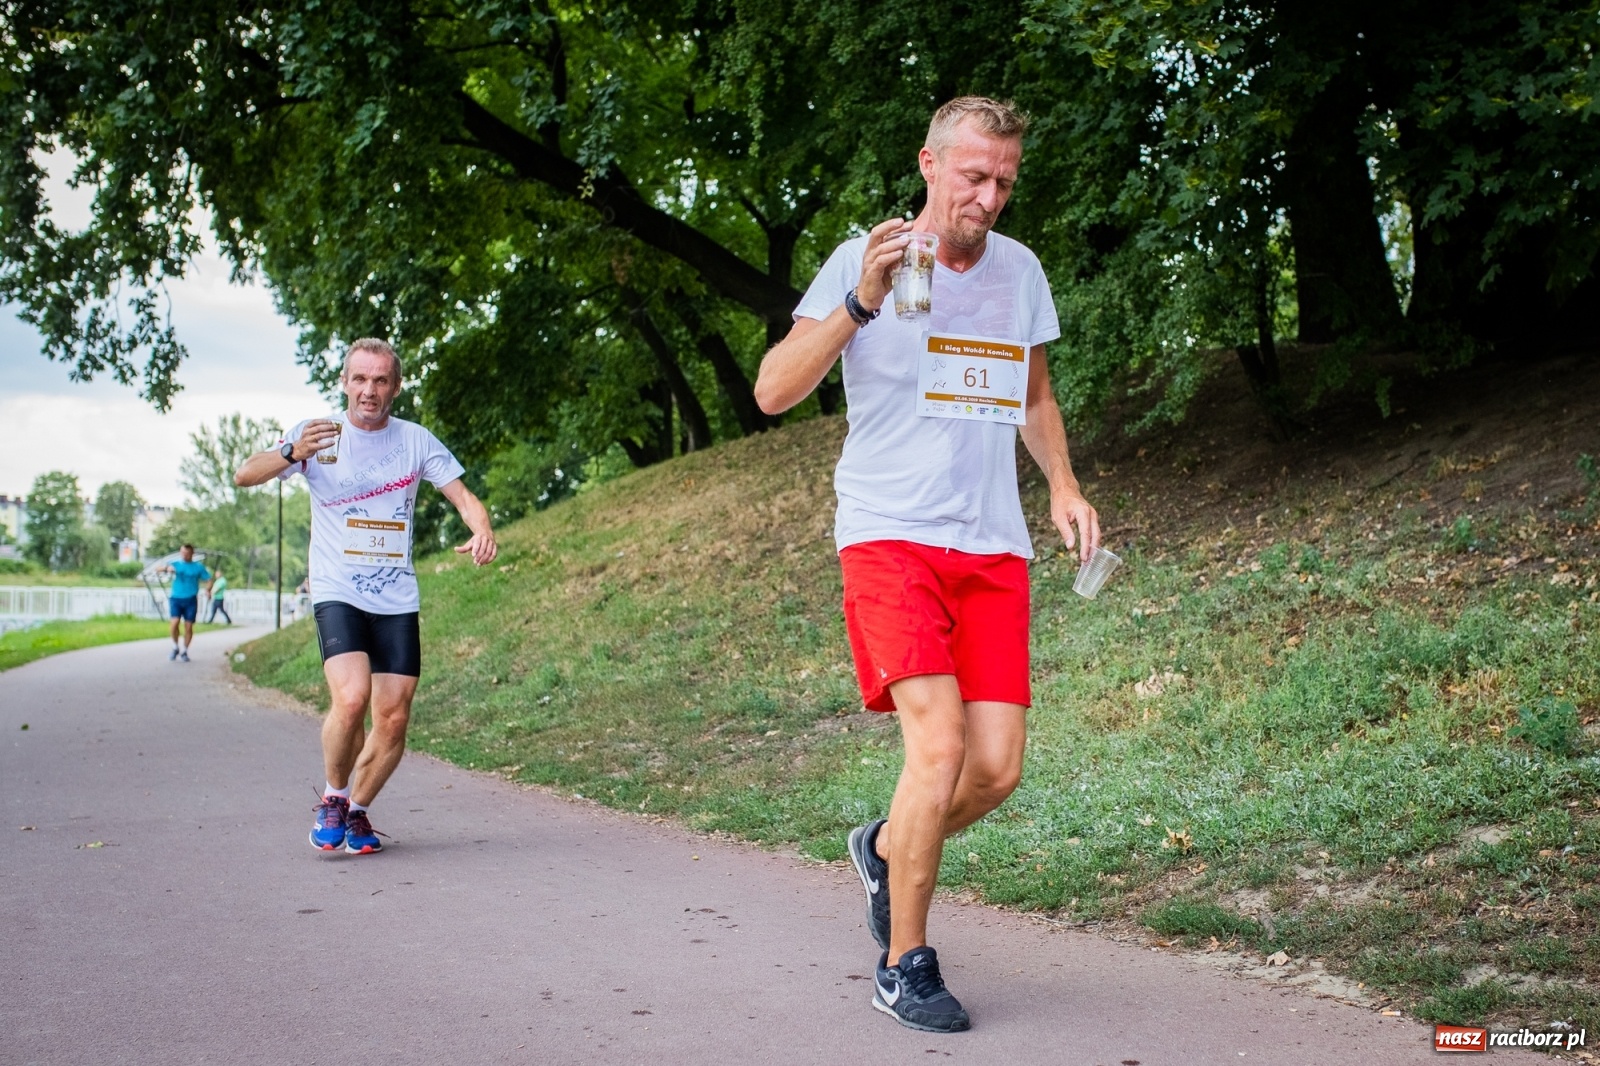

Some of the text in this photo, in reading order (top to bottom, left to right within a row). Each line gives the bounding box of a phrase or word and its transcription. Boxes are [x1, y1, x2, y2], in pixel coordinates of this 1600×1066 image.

[944, 344, 961, 353] Bieg
[986, 348, 1014, 357] Komina
[963, 367, 990, 389] 61
[339, 443, 407, 488] KS GRYF KIETRZ
[368, 535, 385, 549] 34
